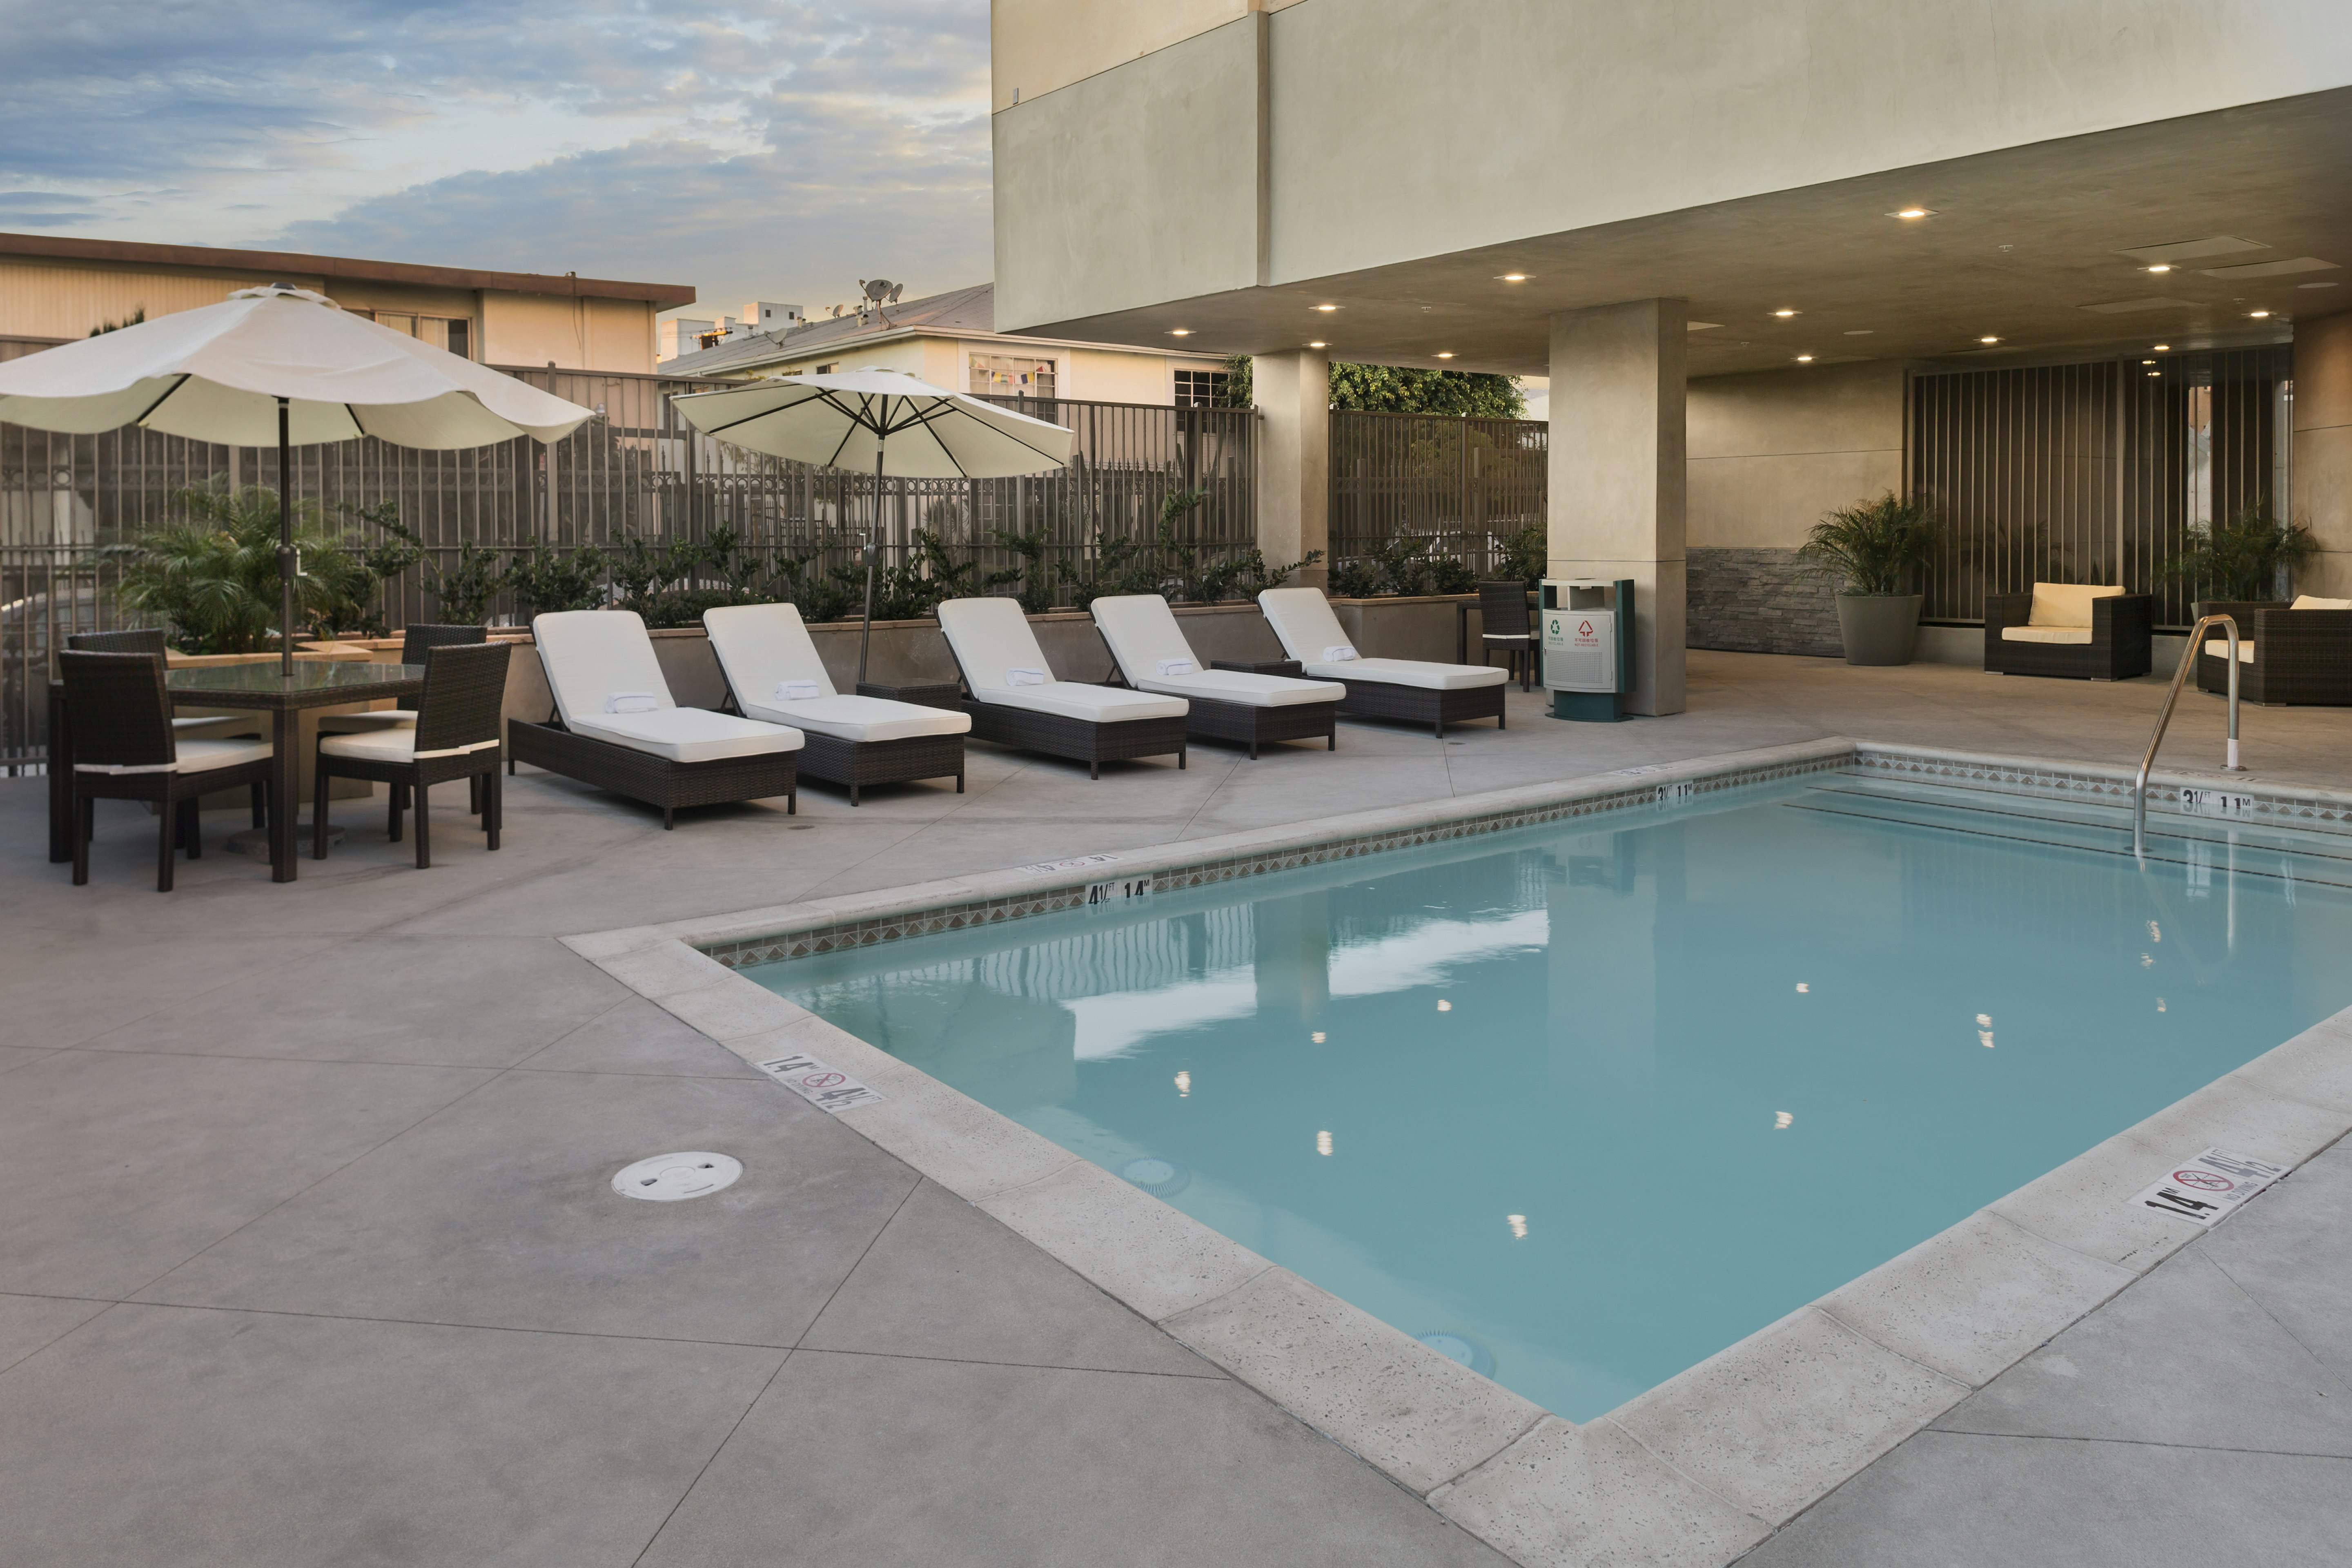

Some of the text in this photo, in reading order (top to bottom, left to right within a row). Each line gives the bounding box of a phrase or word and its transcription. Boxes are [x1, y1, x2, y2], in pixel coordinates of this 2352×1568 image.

[2243, 798, 2250, 806] M
[1109, 882, 1115, 891] FT
[791, 1082, 813, 1094] DIVING
[2223, 1181, 2258, 1201] NO DIVING
